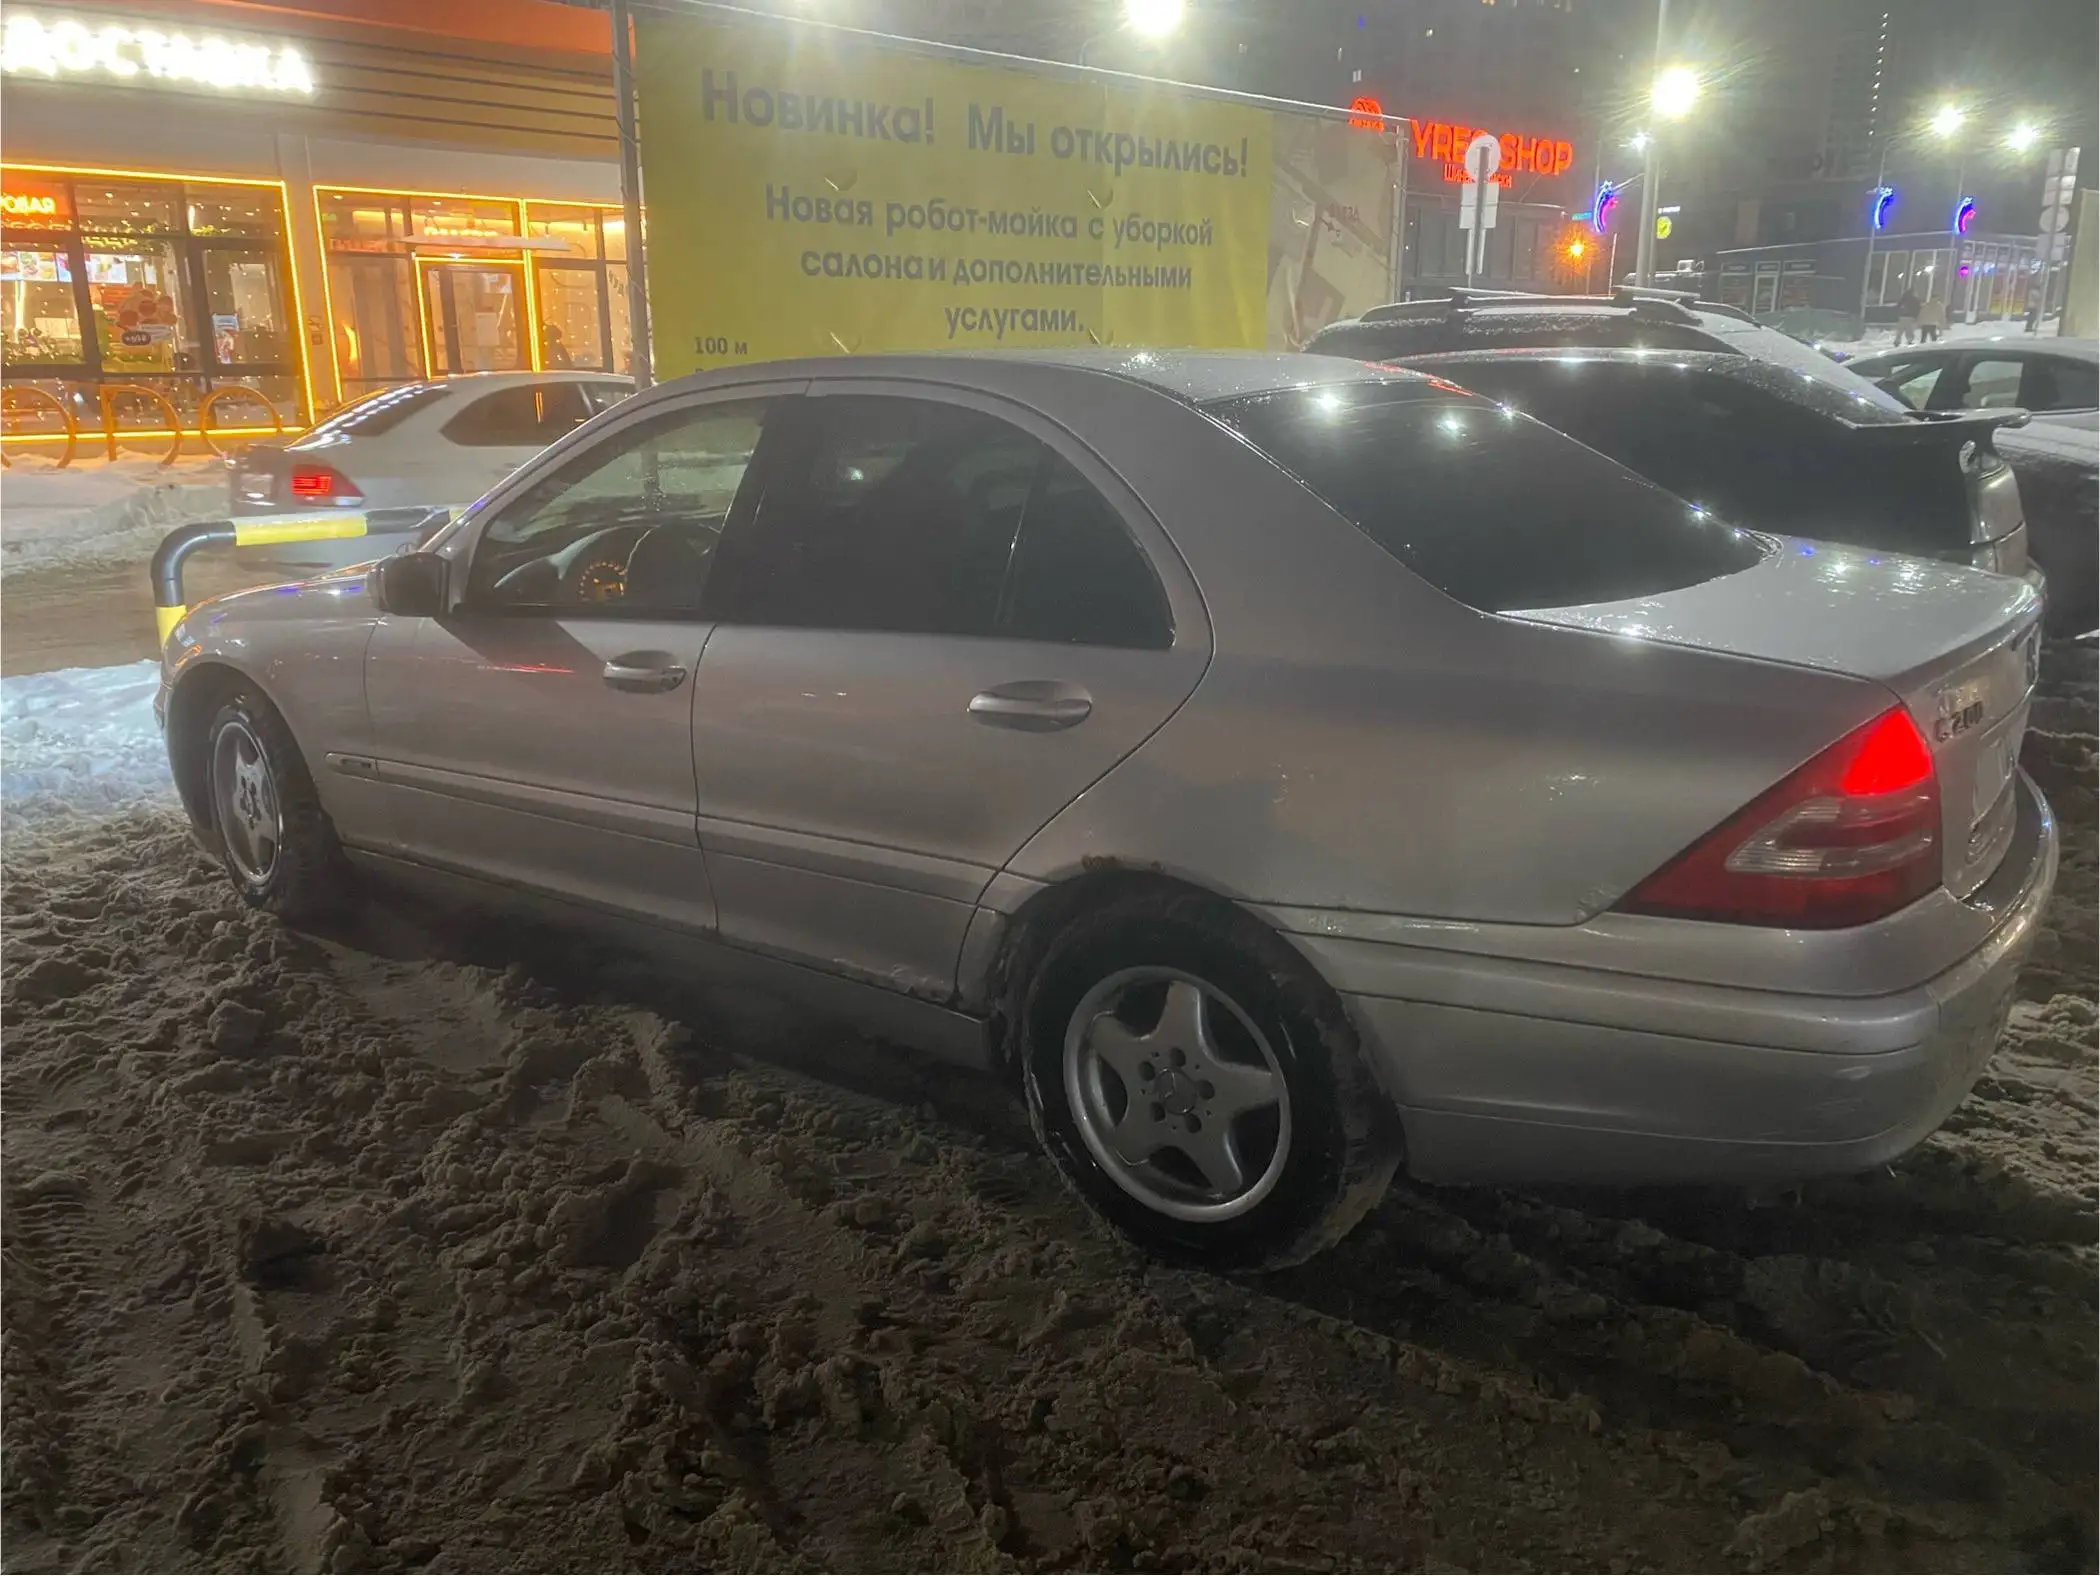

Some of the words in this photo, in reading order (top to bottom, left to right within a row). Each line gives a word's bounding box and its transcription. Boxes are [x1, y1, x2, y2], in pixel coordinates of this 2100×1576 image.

[1, 16, 313, 92] ДОСТАВКА
[702, 68, 934, 145] Новинка!
[968, 104, 1035, 155] Мы
[1051, 126, 1247, 177] открылись!
[1410, 119, 1488, 163] YRE
[1500, 133, 1573, 175] SHOP
[0, 195, 57, 215] ОВАЯ
[765, 183, 873, 227] Новая
[886, 197, 1077, 237] робот-мойка
[1089, 217, 1104, 240] с
[1113, 213, 1212, 251] уборкой
[801, 250, 923, 280] салона
[928, 257, 946, 281] и
[952, 258, 1191, 289] дополнительными
[694, 336, 728, 355] 100
[944, 306, 1084, 340] услугами.
